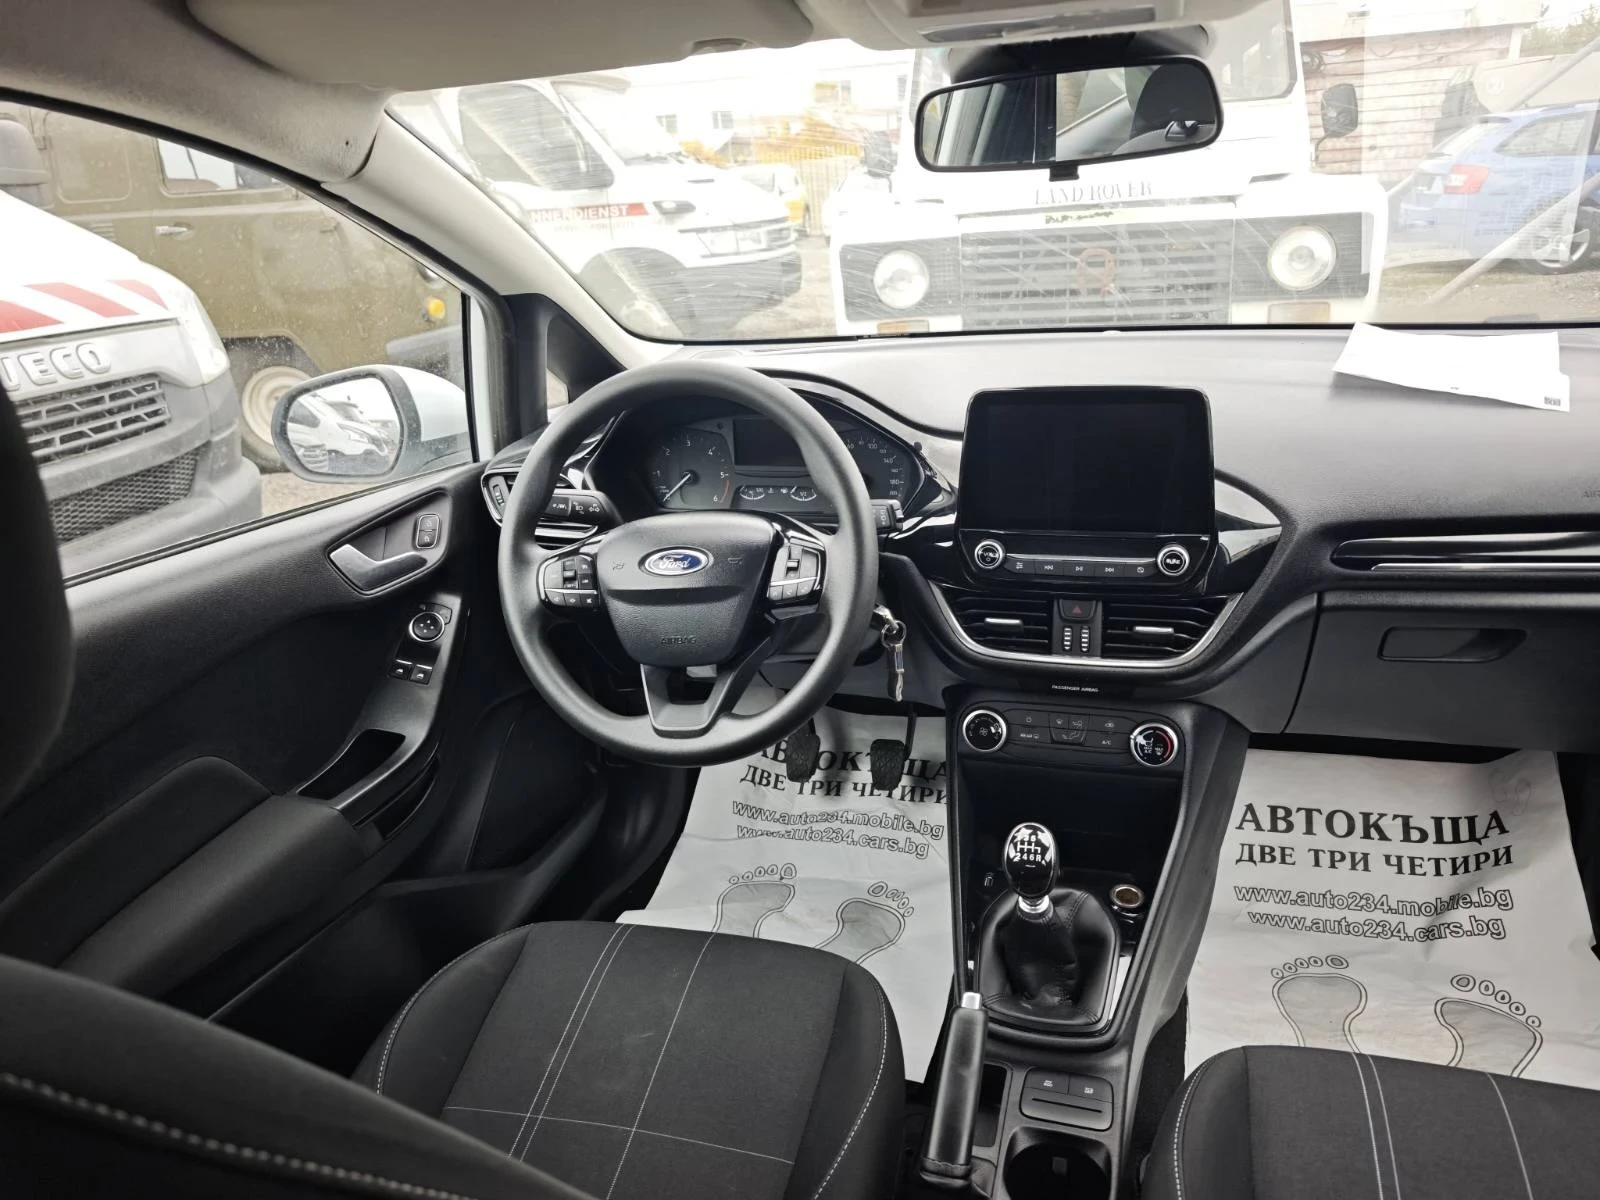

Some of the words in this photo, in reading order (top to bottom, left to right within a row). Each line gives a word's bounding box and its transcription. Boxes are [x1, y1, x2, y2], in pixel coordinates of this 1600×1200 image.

[1035, 186, 1083, 205] LAND
[1090, 180, 1152, 201] ROVER
[739, 764, 787, 792] ДВЕ
[732, 800, 945, 840] www.auto234.mobile.bg
[1235, 802, 1510, 847] АВТОКЪЩА
[1235, 842, 1297, 867] ДВЕ
[1307, 848, 1372, 873] ТРИ
[1383, 844, 1514, 877] ЧЕТИРИ
[1233, 884, 1514, 917] www.auto234.mobile.bg
[1247, 910, 1507, 942] www.auto234.cars.bg
